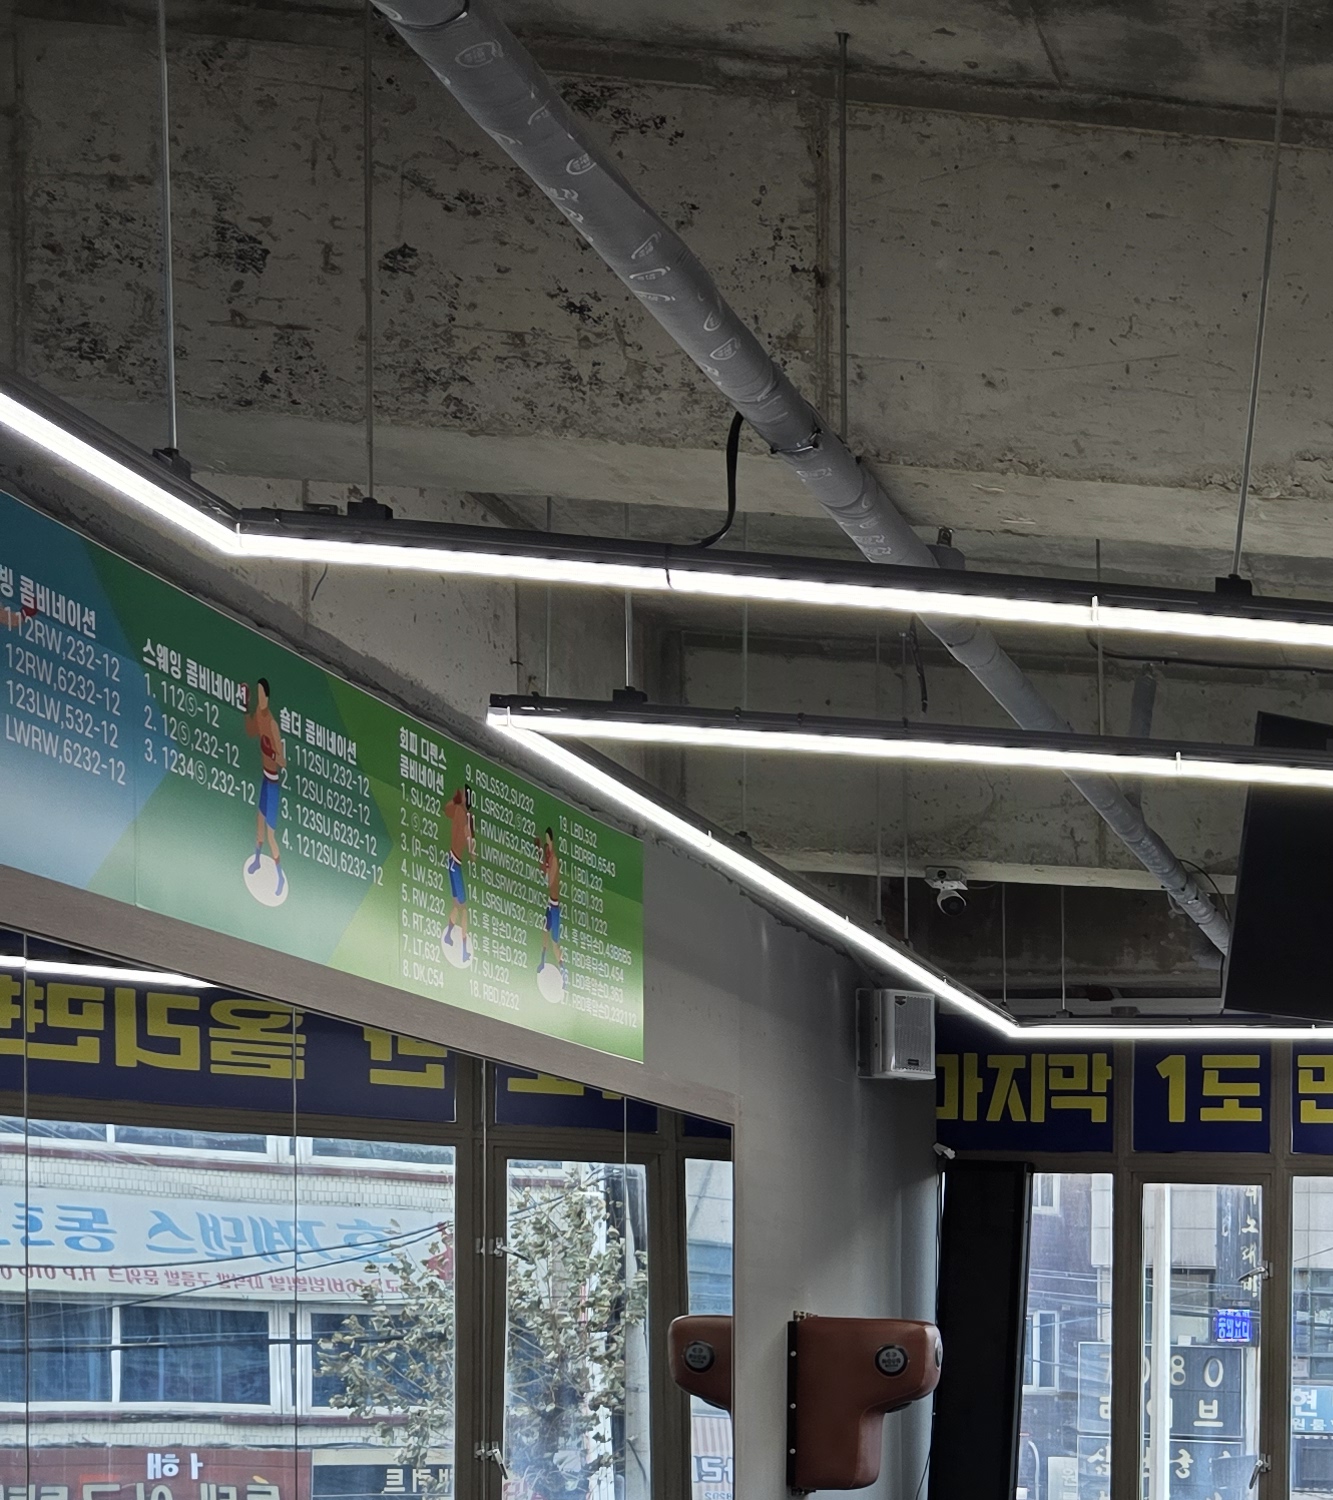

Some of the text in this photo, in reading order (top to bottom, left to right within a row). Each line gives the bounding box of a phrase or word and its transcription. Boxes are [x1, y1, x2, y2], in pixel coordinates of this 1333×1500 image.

[20, 575, 96, 639] 콤비네이션
[143, 638, 247, 712] 스웨잉 콤비네이션
[280, 706, 357, 766] 숄더 콤비네이션
